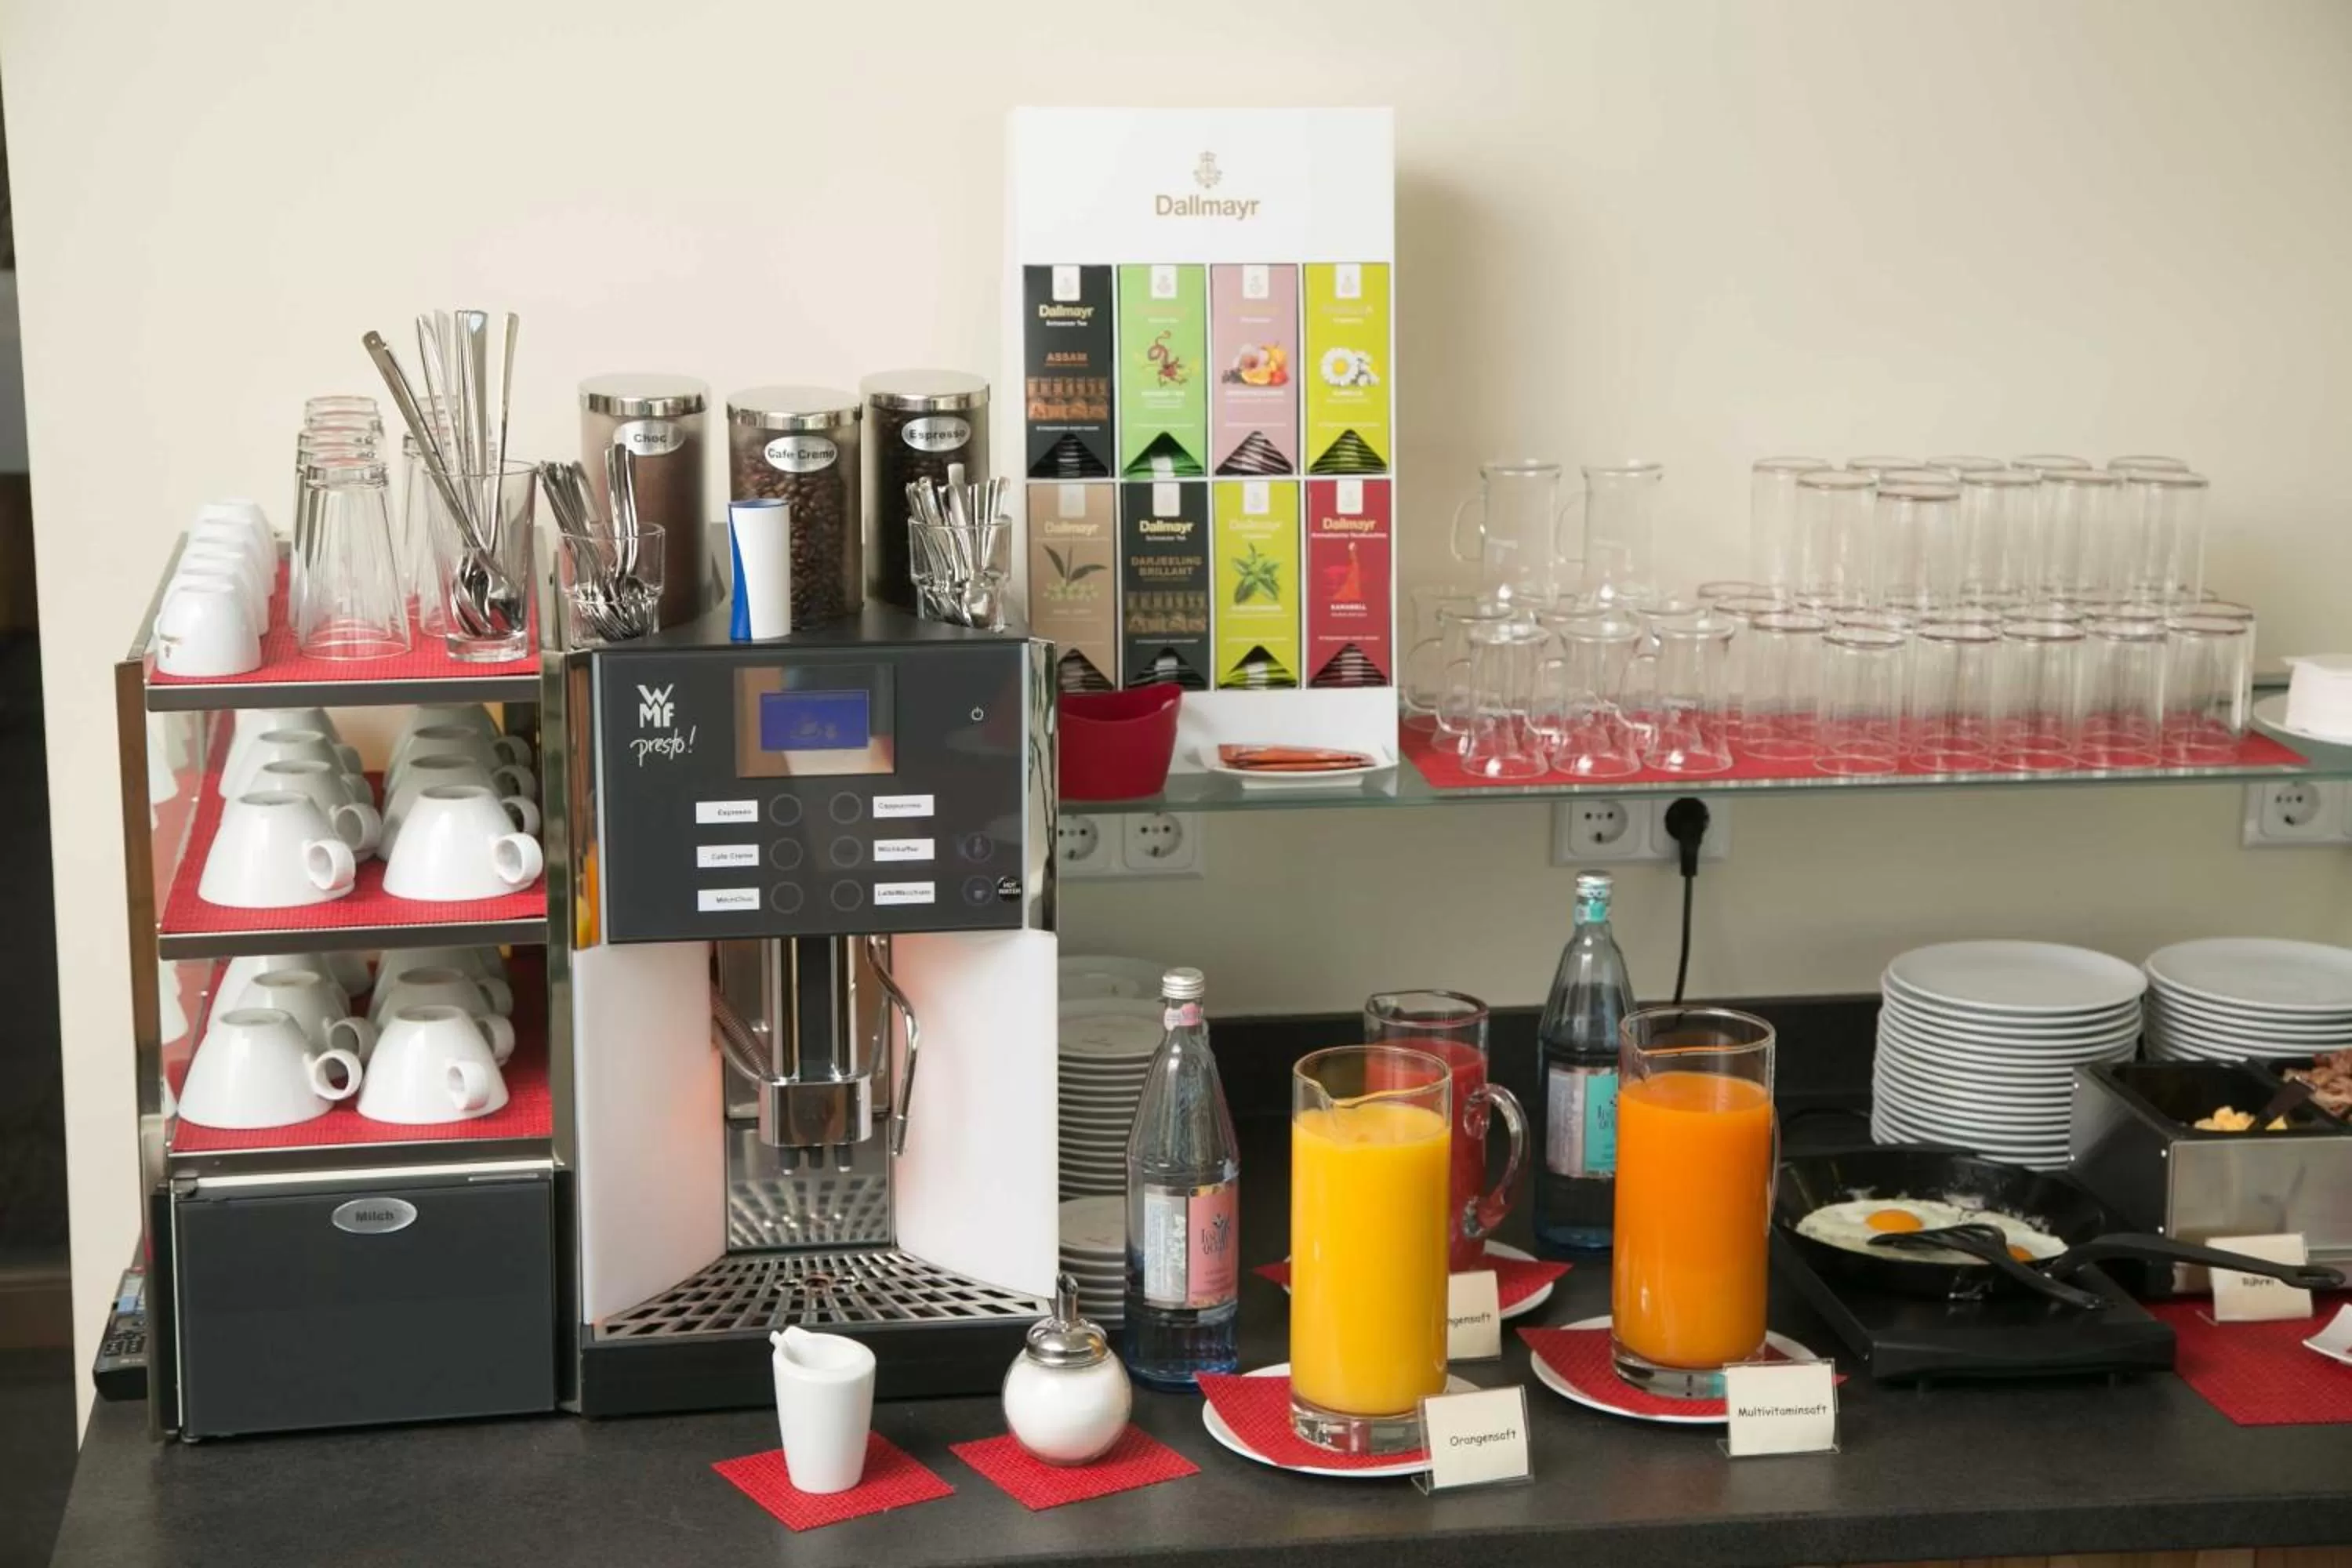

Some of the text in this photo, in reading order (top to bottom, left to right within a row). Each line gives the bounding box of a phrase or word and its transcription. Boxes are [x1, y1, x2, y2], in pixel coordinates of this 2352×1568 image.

[1155, 194, 1261, 221] Dallmayr
[1039, 304, 1094, 319] Dallmayr
[1047, 352, 1087, 361] ASSAM
[633, 434, 666, 443] Choc
[909, 428, 966, 441] Espresso
[797, 448, 835, 460] Creme
[1139, 520, 1194, 535] Dallmayr
[1322, 517, 1377, 532] Dallmayr
[1131, 556, 1203, 566] DARJEELING
[637, 684, 675, 728] WMF
[630, 725, 696, 768] presto!
[355, 1210, 395, 1222] Milch
[1738, 1404, 1827, 1417] Multivitaminsaft
[1450, 1428, 1516, 1447] Orangensaft
